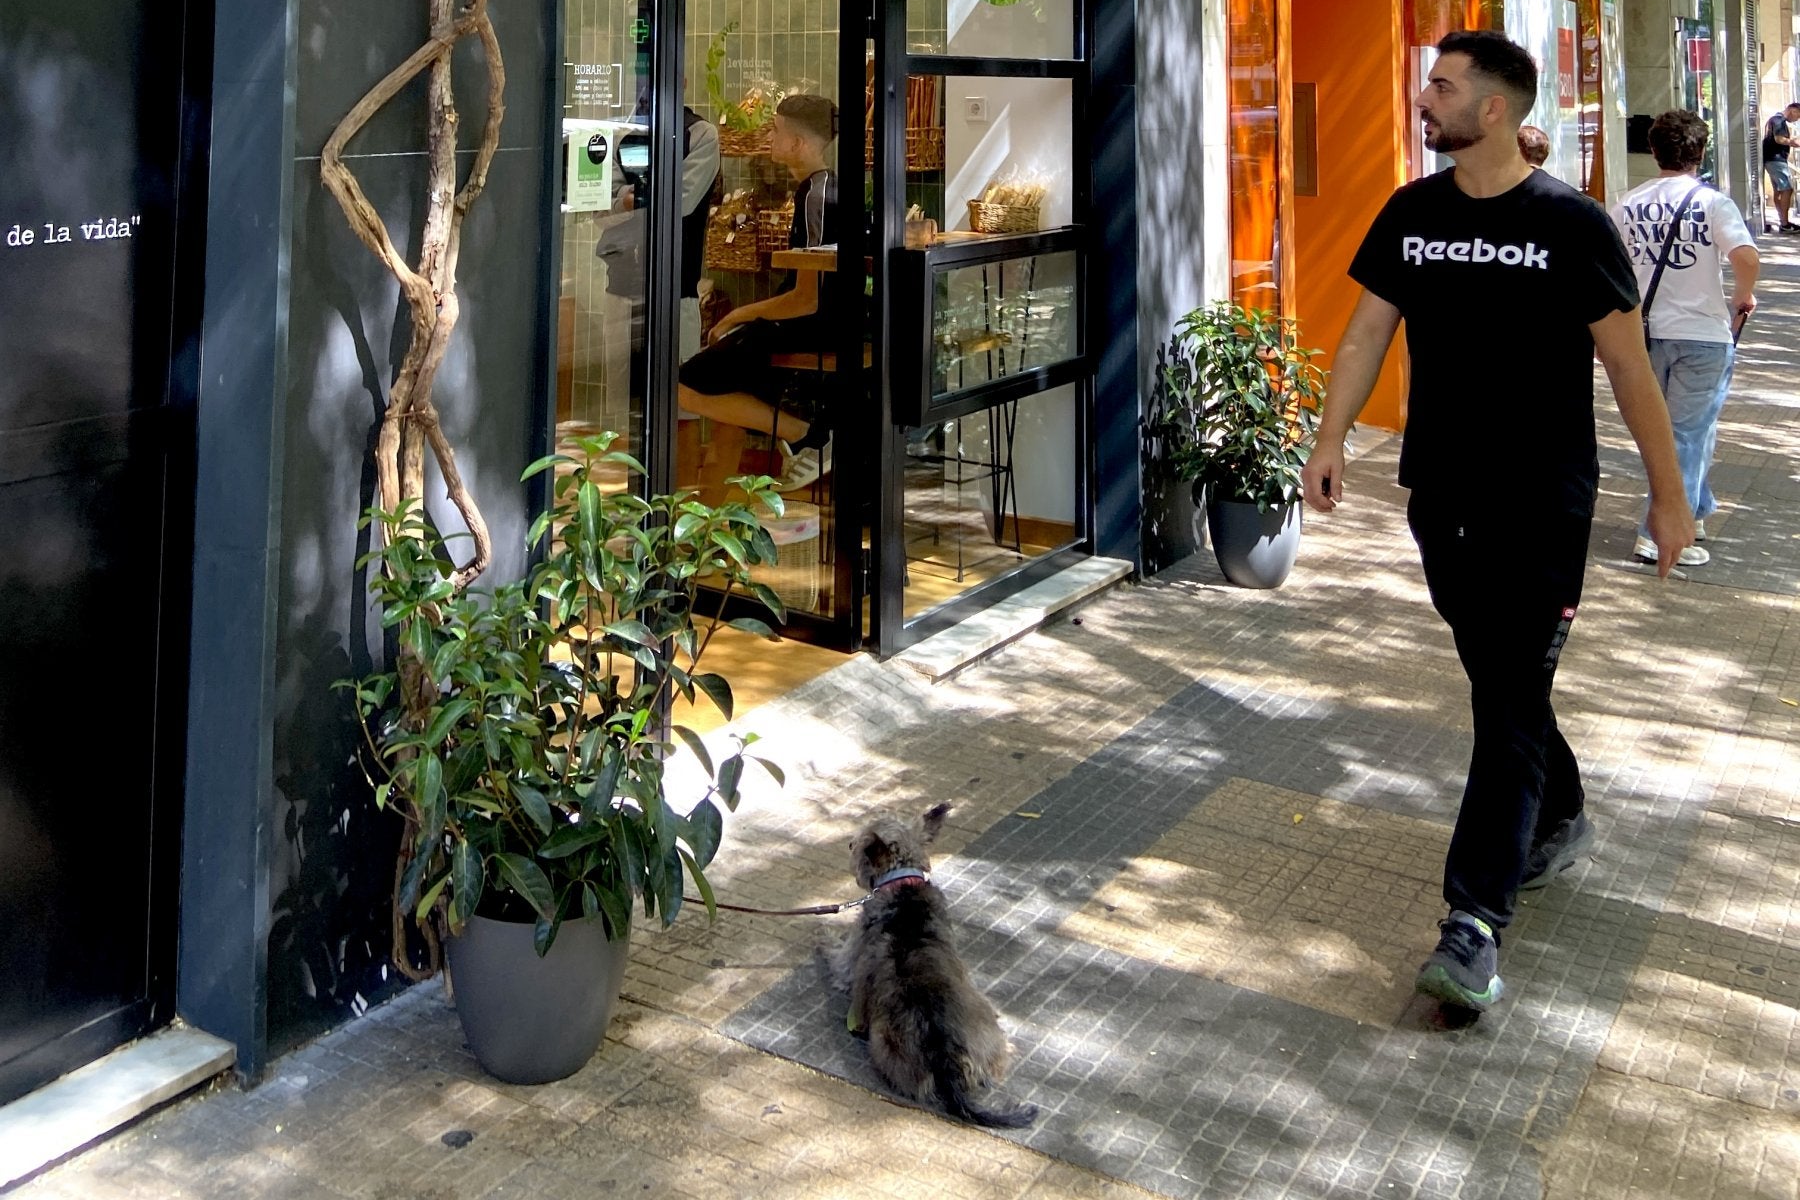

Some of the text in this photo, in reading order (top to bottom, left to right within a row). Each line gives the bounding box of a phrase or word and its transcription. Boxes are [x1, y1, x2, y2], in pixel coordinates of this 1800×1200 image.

[574, 64, 612, 75] HORARIO
[7, 224, 35, 247] de
[43, 223, 72, 244] la
[1402, 236, 1549, 270] Reebok
[1631, 243, 1697, 270] PAIS
